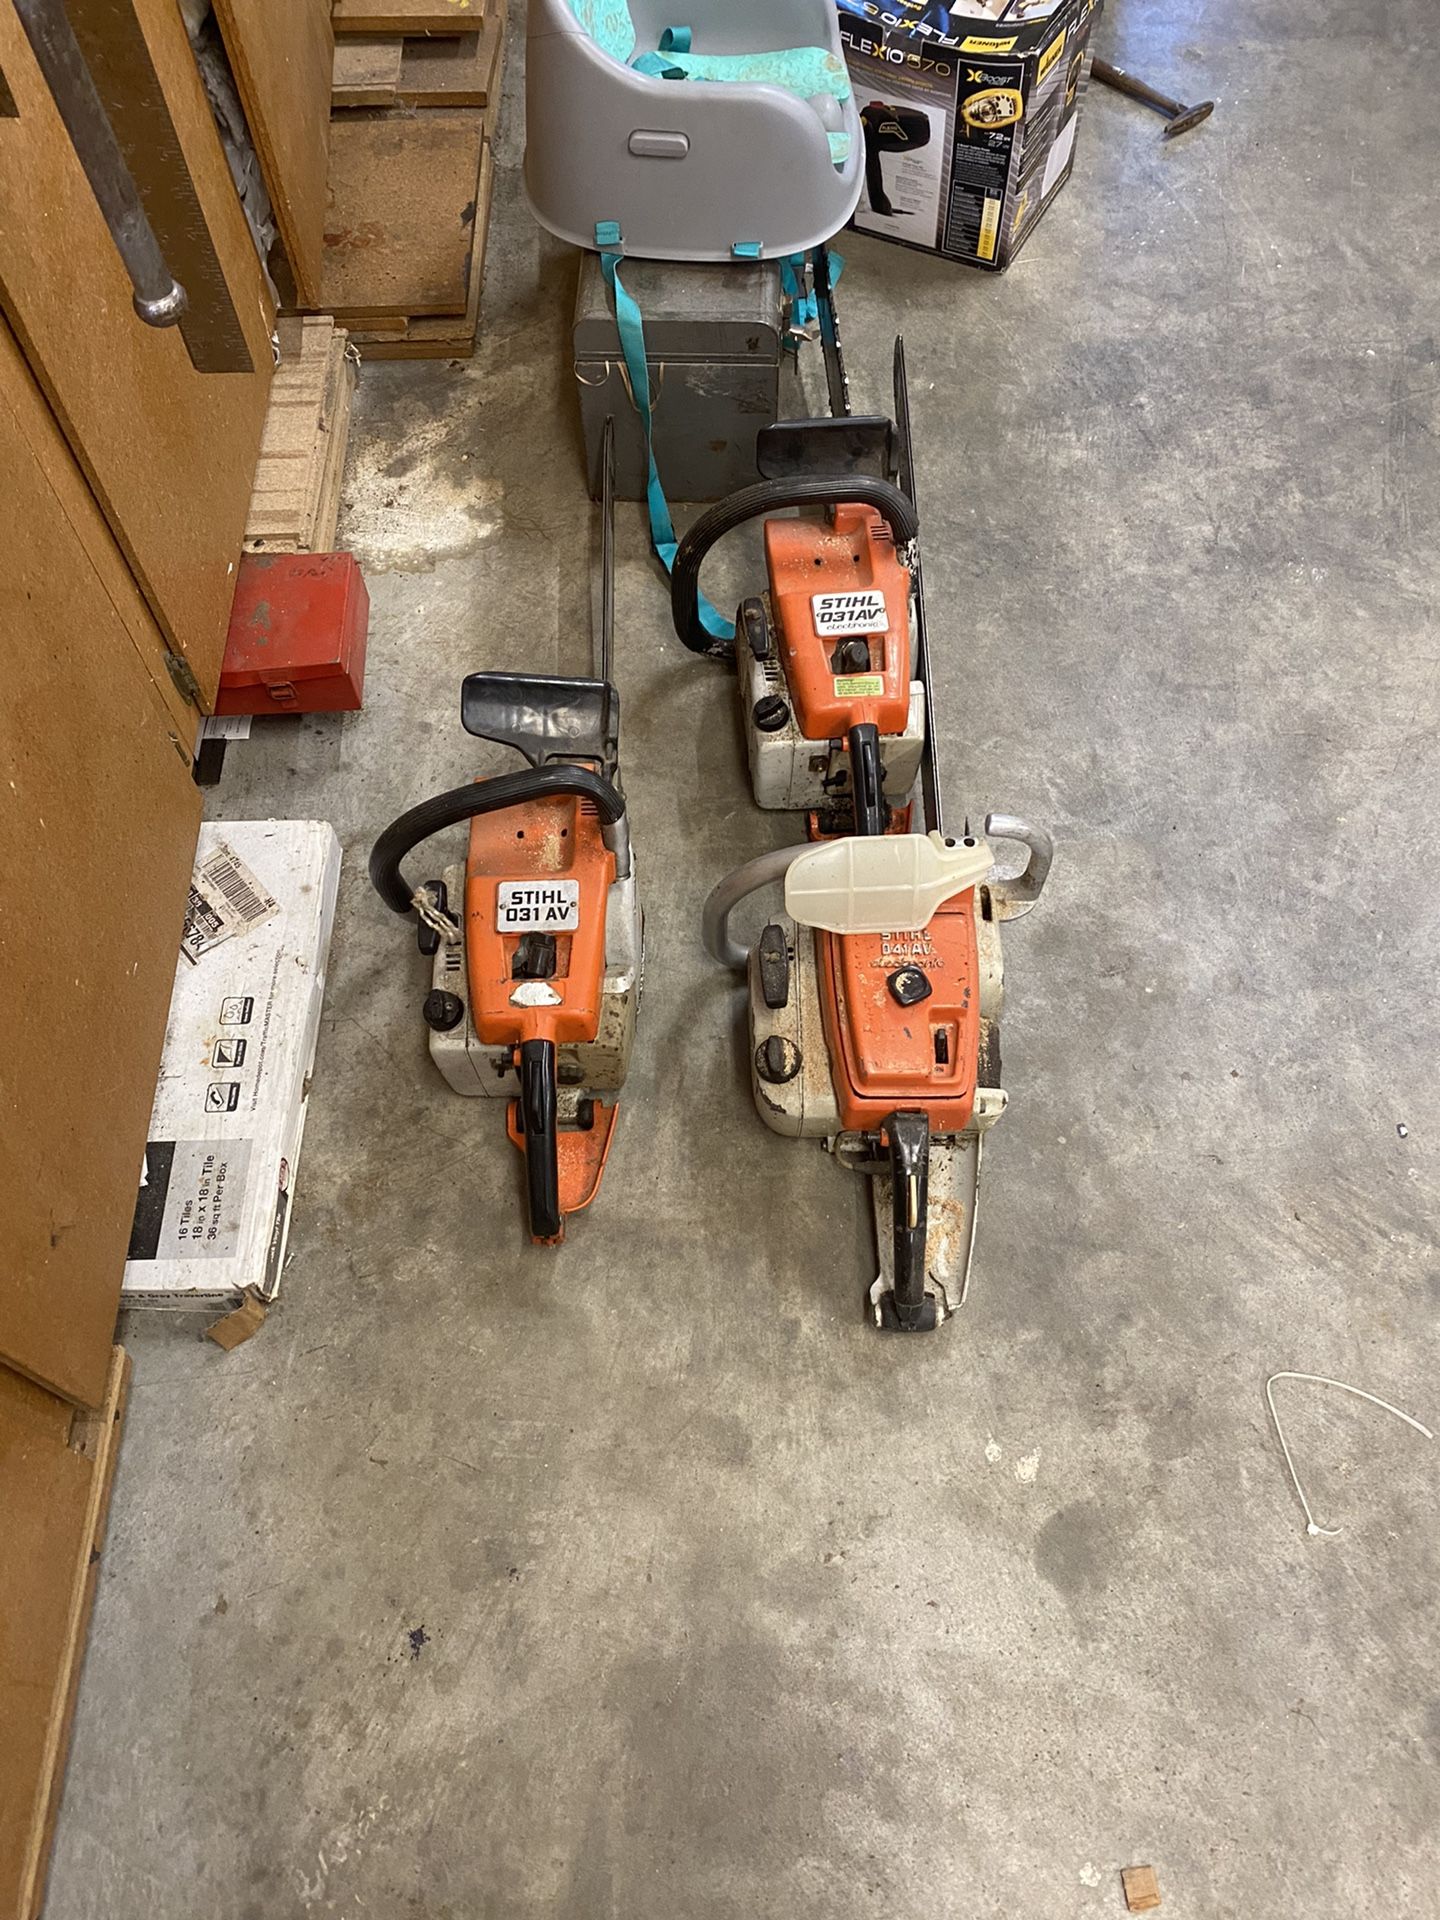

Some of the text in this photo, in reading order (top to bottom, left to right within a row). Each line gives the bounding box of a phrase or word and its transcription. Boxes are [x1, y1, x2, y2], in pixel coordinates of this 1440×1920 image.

[880, 12, 959, 46] FLEXIO
[840, 31, 904, 64] FLEXIO
[907, 53, 951, 77] 570
[820, 595, 879, 610] STIHL
[826, 621, 880, 630] electronic
[511, 890, 567, 905] STIHL
[206, 913, 219, 928] 005
[506, 907, 570, 922] 031 AV
[202, 1155, 214, 1176] Tile
[216, 1162, 228, 1182] Box
[198, 1188, 209, 1202] 18
[213, 1185, 224, 1203] Per
[178, 1199, 193, 1240] 16 Tiles
[212, 1213, 221, 1225] sq
[192, 1226, 203, 1240] 18
[207, 1227, 217, 1240] 36
